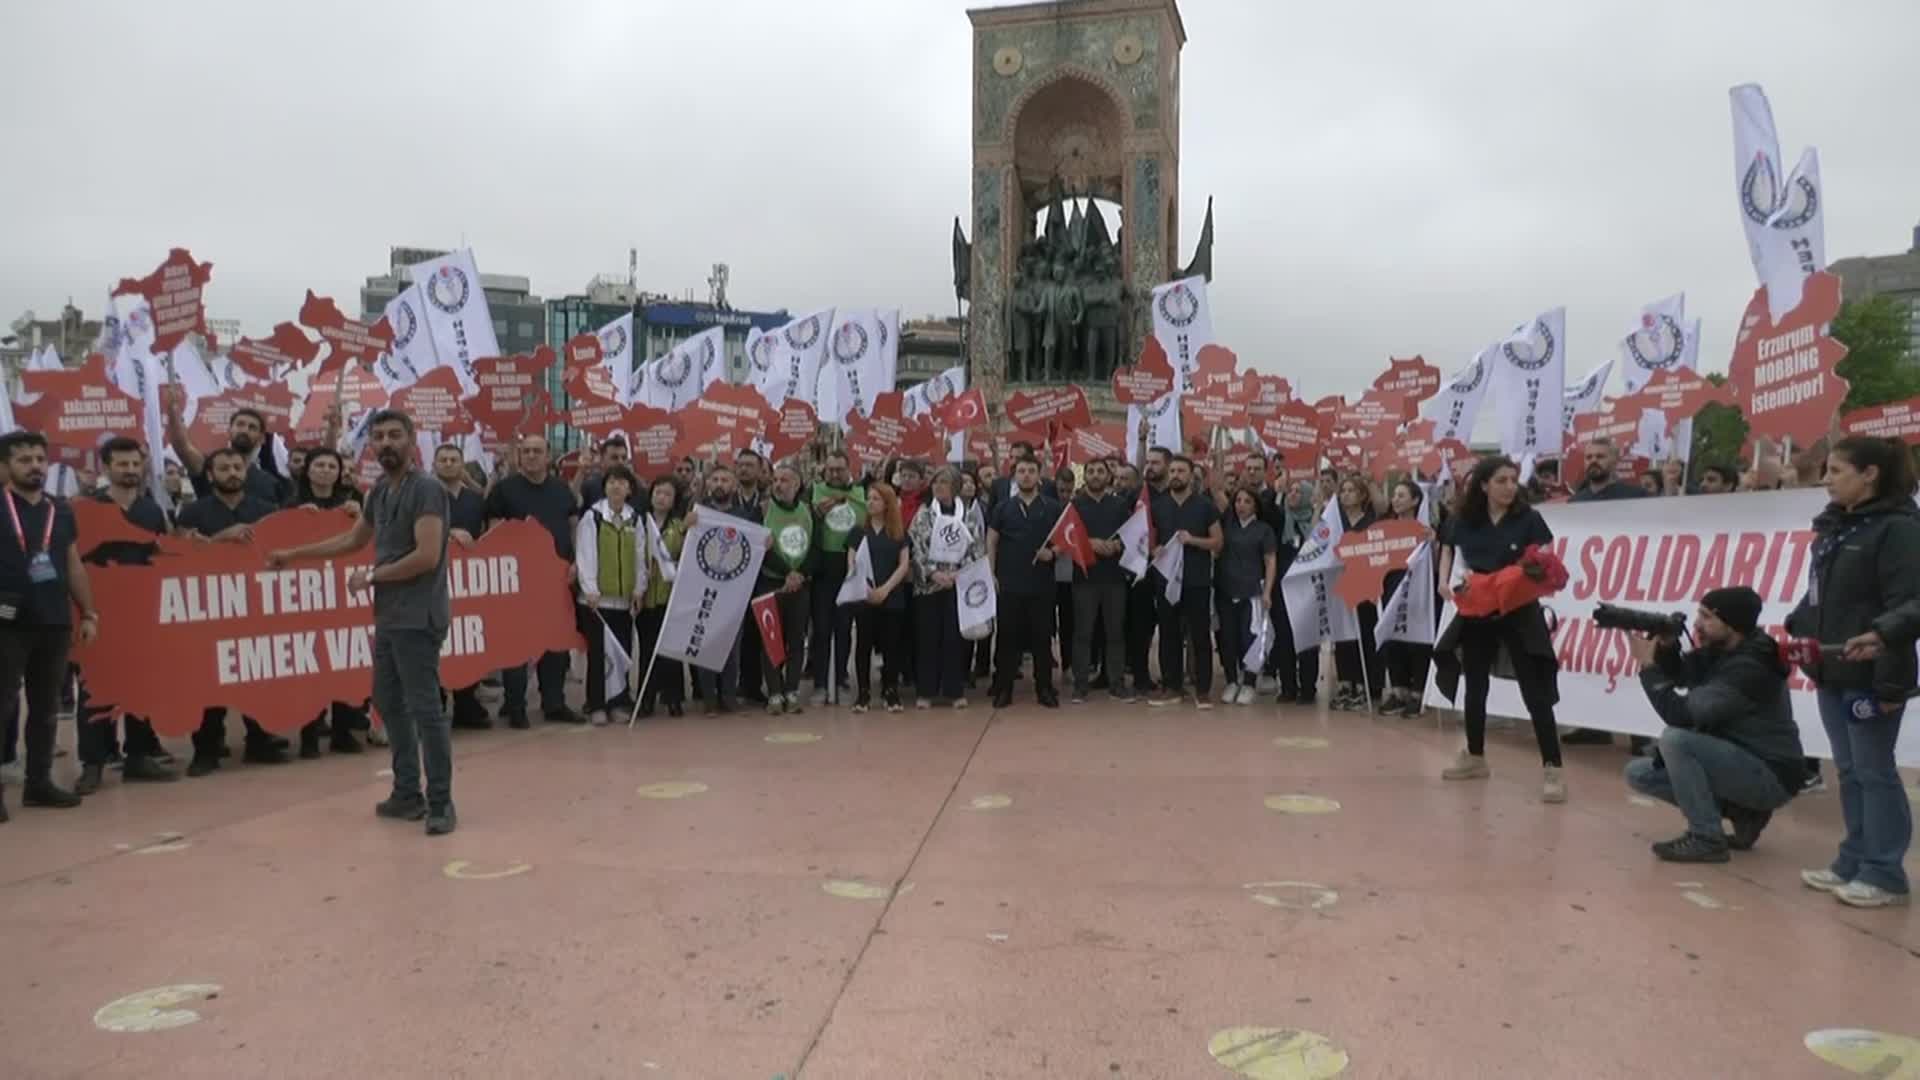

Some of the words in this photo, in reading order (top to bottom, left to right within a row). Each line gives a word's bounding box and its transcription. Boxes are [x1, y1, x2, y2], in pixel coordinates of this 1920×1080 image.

[1758, 325, 1815, 361] Erzurum
[1754, 347, 1819, 388] MOBBİNG
[1751, 373, 1824, 415] istemiyor!
[1573, 529, 1818, 602] SOLIDARIT
[159, 573, 248, 625] ALIN
[255, 560, 337, 615] TERİ
[216, 631, 320, 685] EMEK
